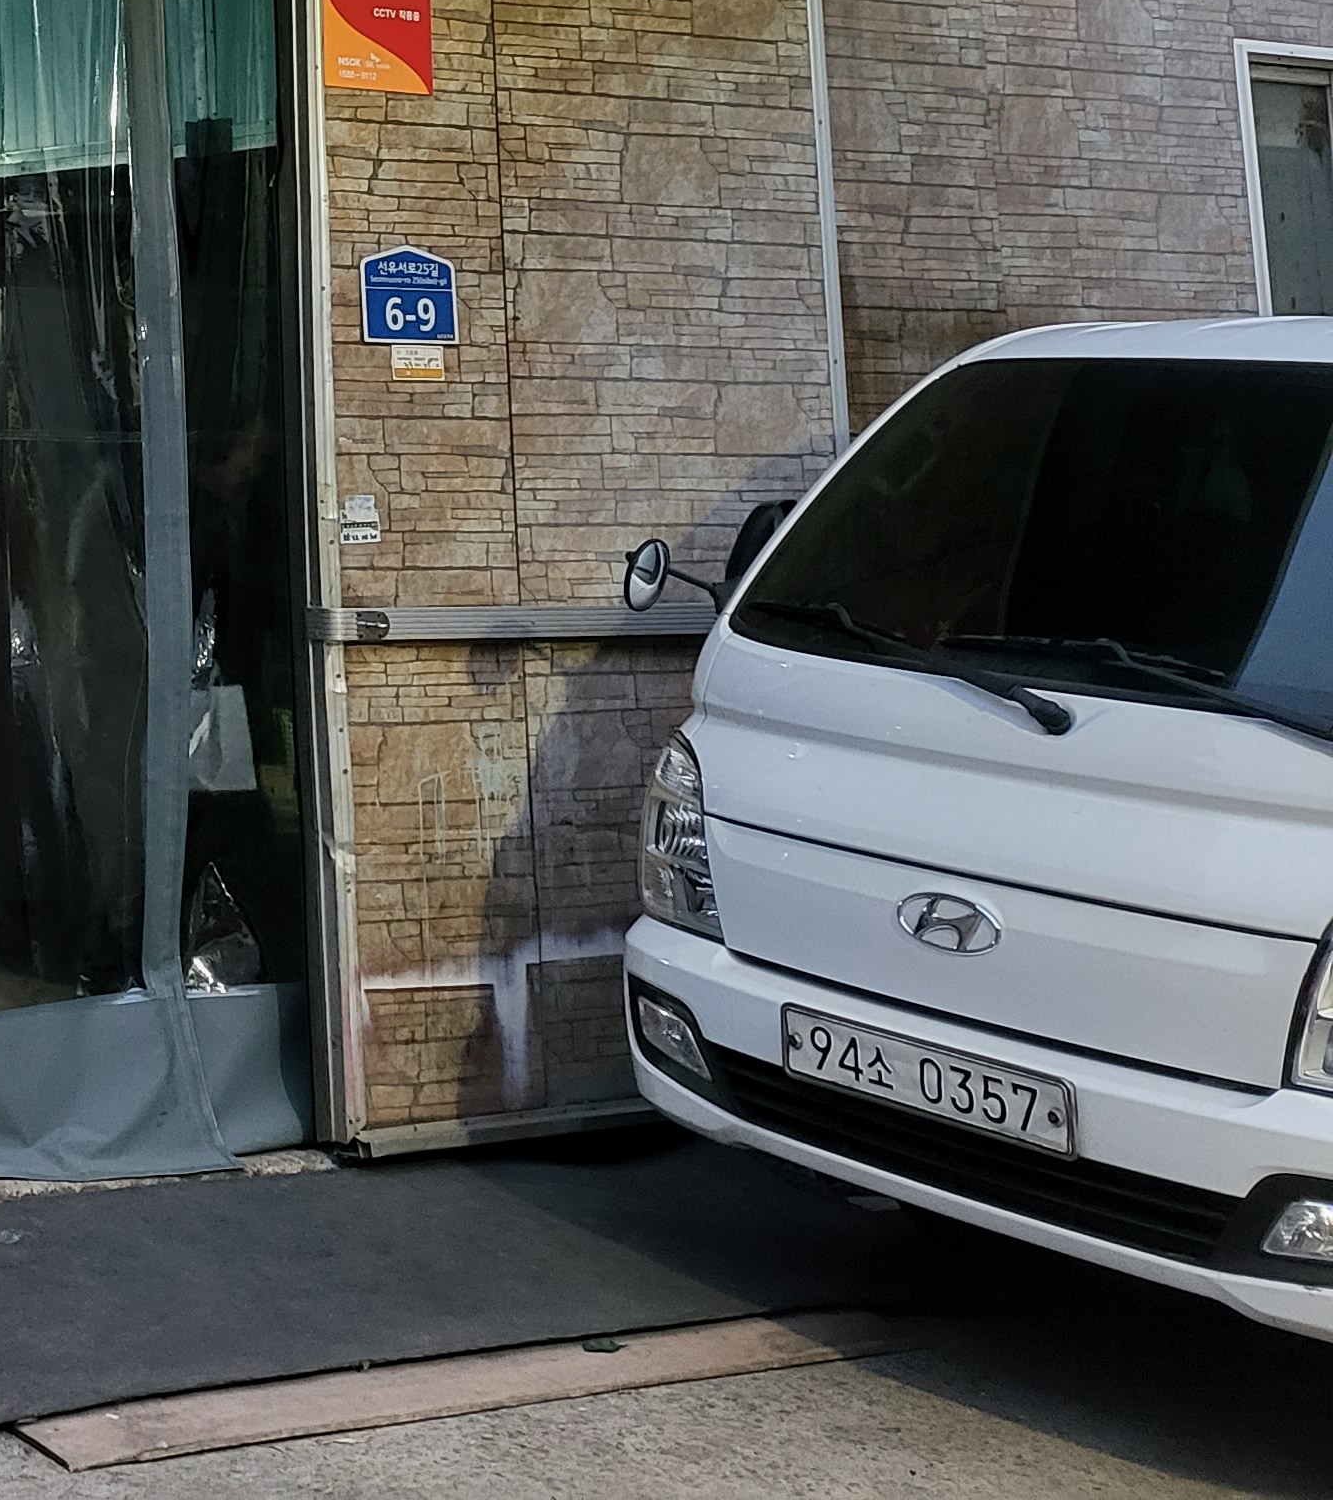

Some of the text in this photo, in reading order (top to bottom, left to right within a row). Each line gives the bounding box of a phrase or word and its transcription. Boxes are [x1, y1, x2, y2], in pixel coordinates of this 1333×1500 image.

[373, 7, 397, 19] CCTV
[337, 56, 362, 67] NSOK
[377, 260, 439, 277] 선유서로25길
[385, 297, 436, 332] 6-9
[809, 1026, 1038, 1131] 94소 0357
